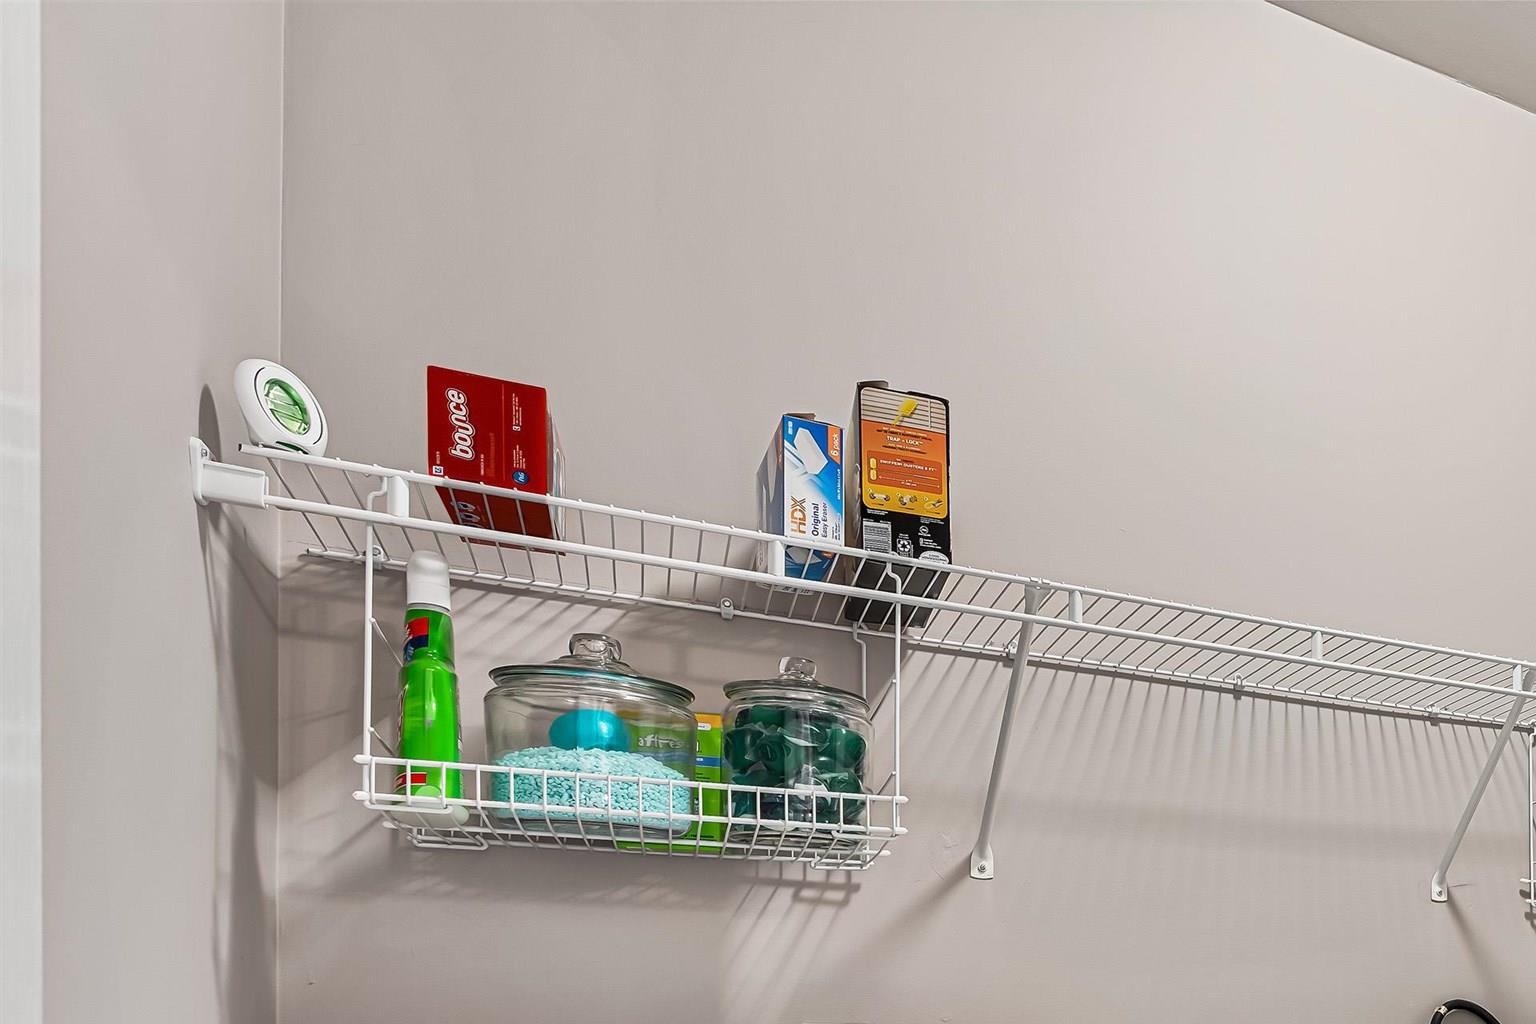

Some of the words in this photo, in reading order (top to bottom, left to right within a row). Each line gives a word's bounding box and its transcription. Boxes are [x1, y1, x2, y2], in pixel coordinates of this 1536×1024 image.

[446, 388, 475, 460] bounce
[832, 433, 840, 450] pack
[791, 495, 806, 534] HDX
[811, 502, 821, 536] Original
[821, 522, 829, 538] Easy
